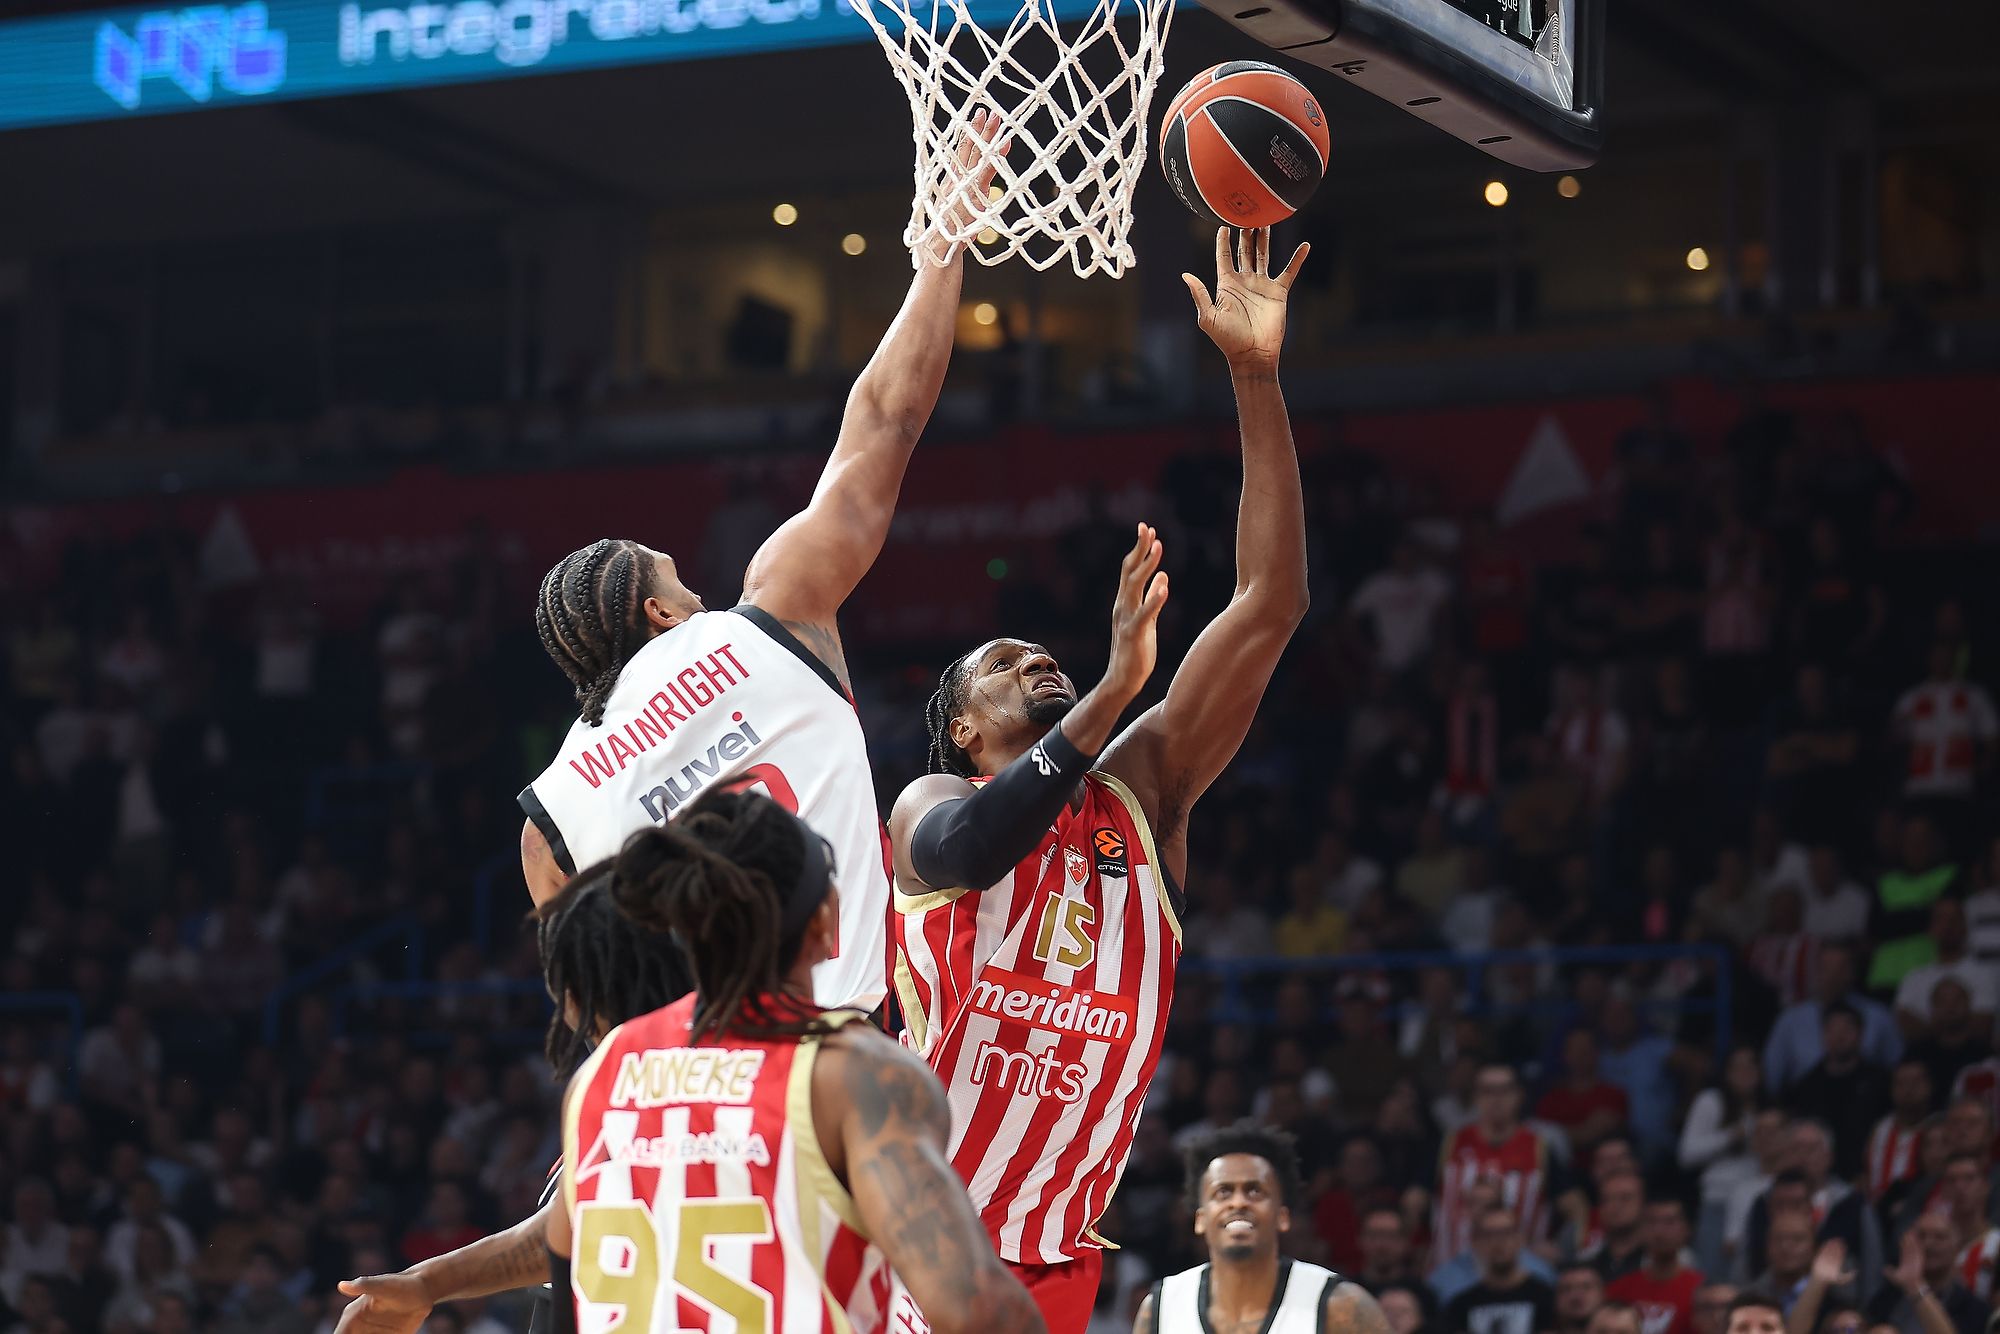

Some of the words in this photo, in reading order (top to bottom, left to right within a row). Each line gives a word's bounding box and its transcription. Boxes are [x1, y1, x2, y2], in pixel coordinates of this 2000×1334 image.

[569, 643, 750, 789] WAINRIGHT
[638, 711, 762, 823] nuvei
[1033, 891, 1095, 971] 15
[968, 979, 1129, 1039] meridian
[612, 1049, 763, 1107] MONEKE
[970, 1040, 1088, 1104] mts
[572, 1200, 775, 1334] 95
